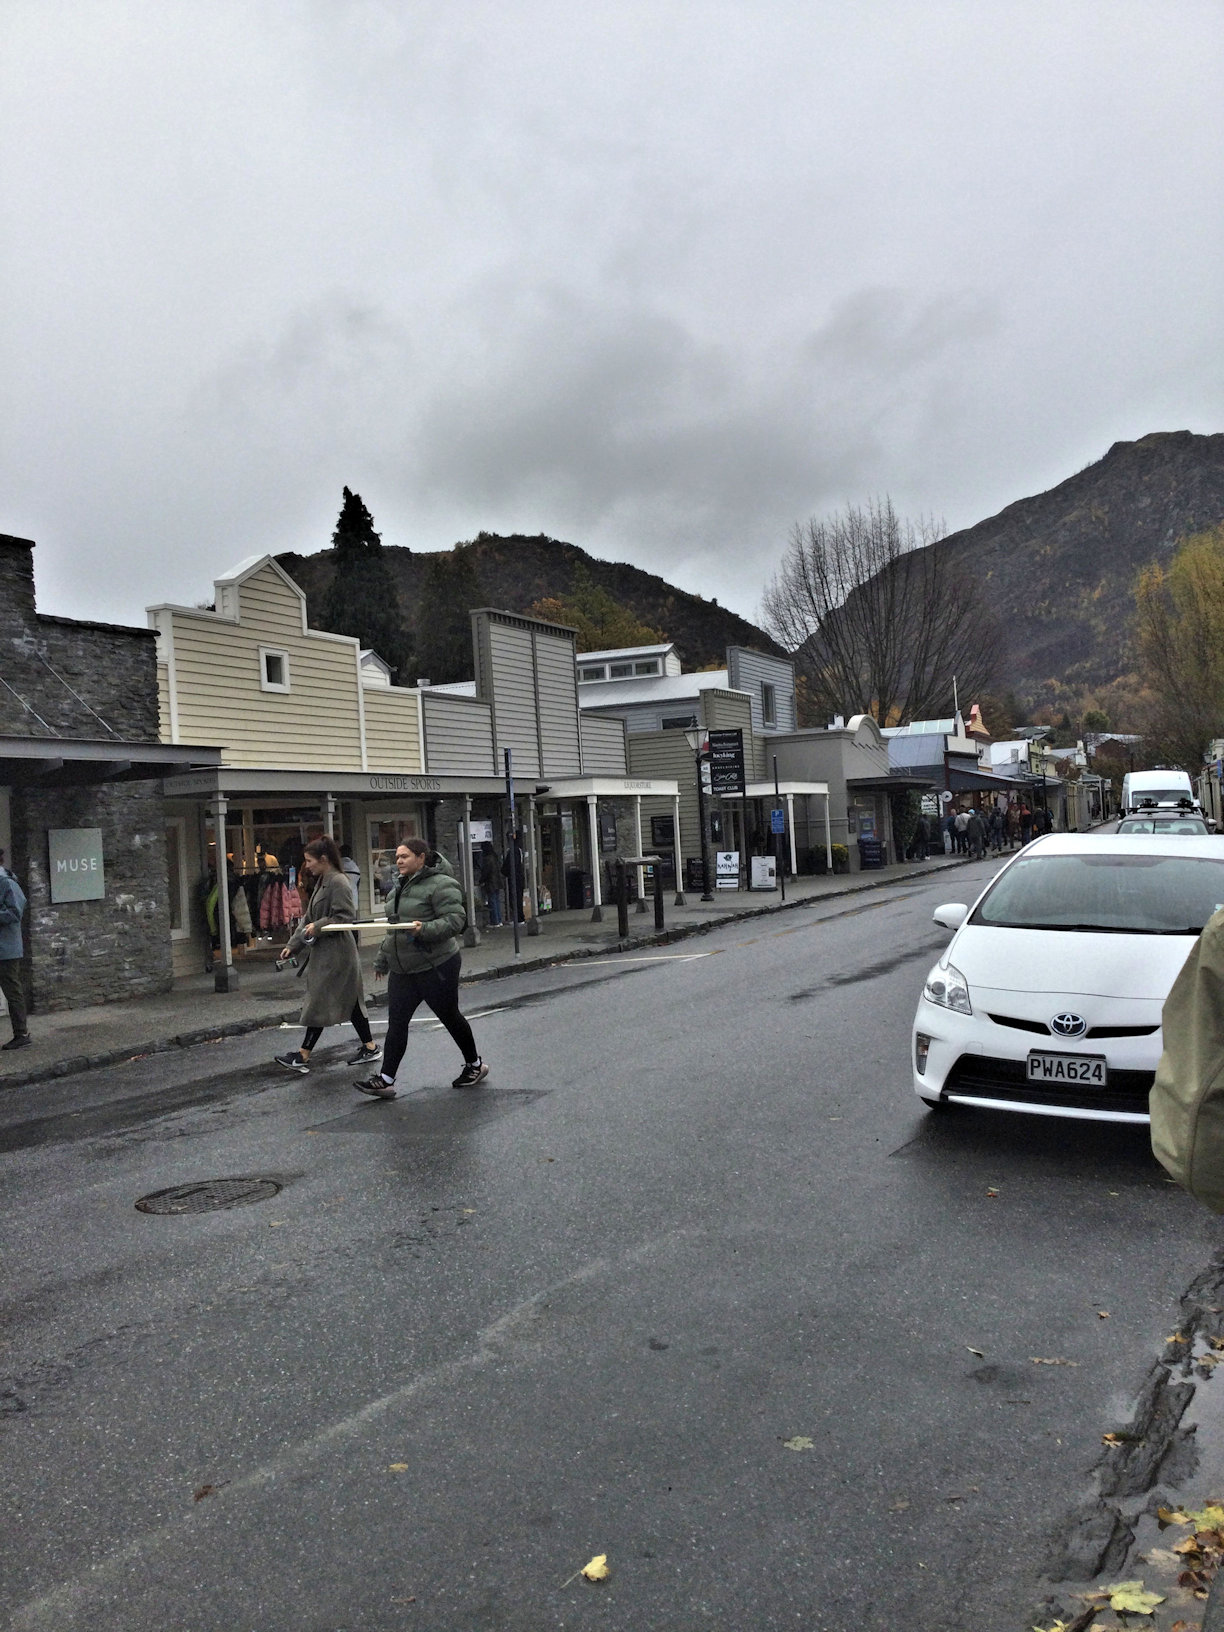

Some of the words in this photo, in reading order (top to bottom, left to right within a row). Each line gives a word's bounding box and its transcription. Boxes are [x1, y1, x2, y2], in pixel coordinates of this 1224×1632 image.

[370, 776, 408, 790] OUTSIDE
[411, 777, 441, 791] SPORTS
[56, 858, 98, 873] MUSE
[1030, 1058, 1103, 1082] PWA624
